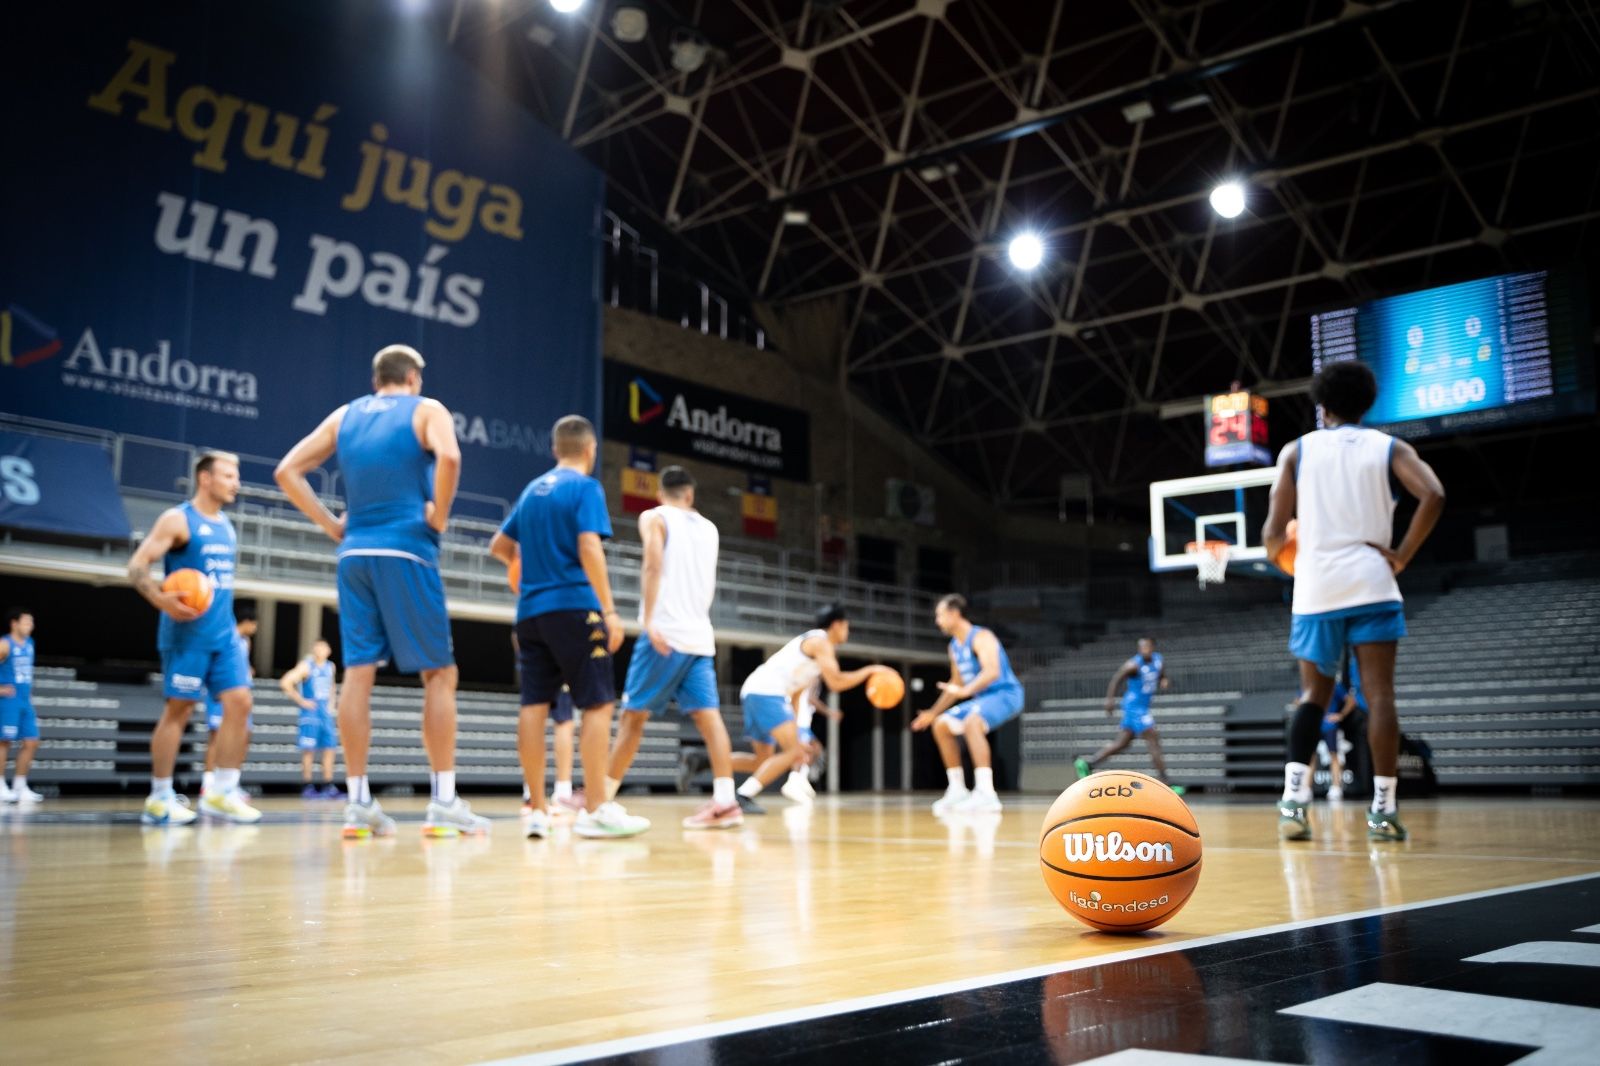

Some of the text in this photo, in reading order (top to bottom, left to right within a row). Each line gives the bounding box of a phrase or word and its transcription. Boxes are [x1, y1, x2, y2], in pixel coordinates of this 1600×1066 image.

[88, 39, 524, 241] Aquí juga
[153, 191, 485, 328] un país
[62, 326, 259, 402] Andorra
[1414, 377, 1486, 410] 10:00
[666, 393, 782, 452] Andorra
[1209, 411, 1247, 446] 24
[1088, 784, 1134, 799] acb
[1062, 831, 1175, 863] Wilson
[1069, 890, 1169, 912] liga endesa
